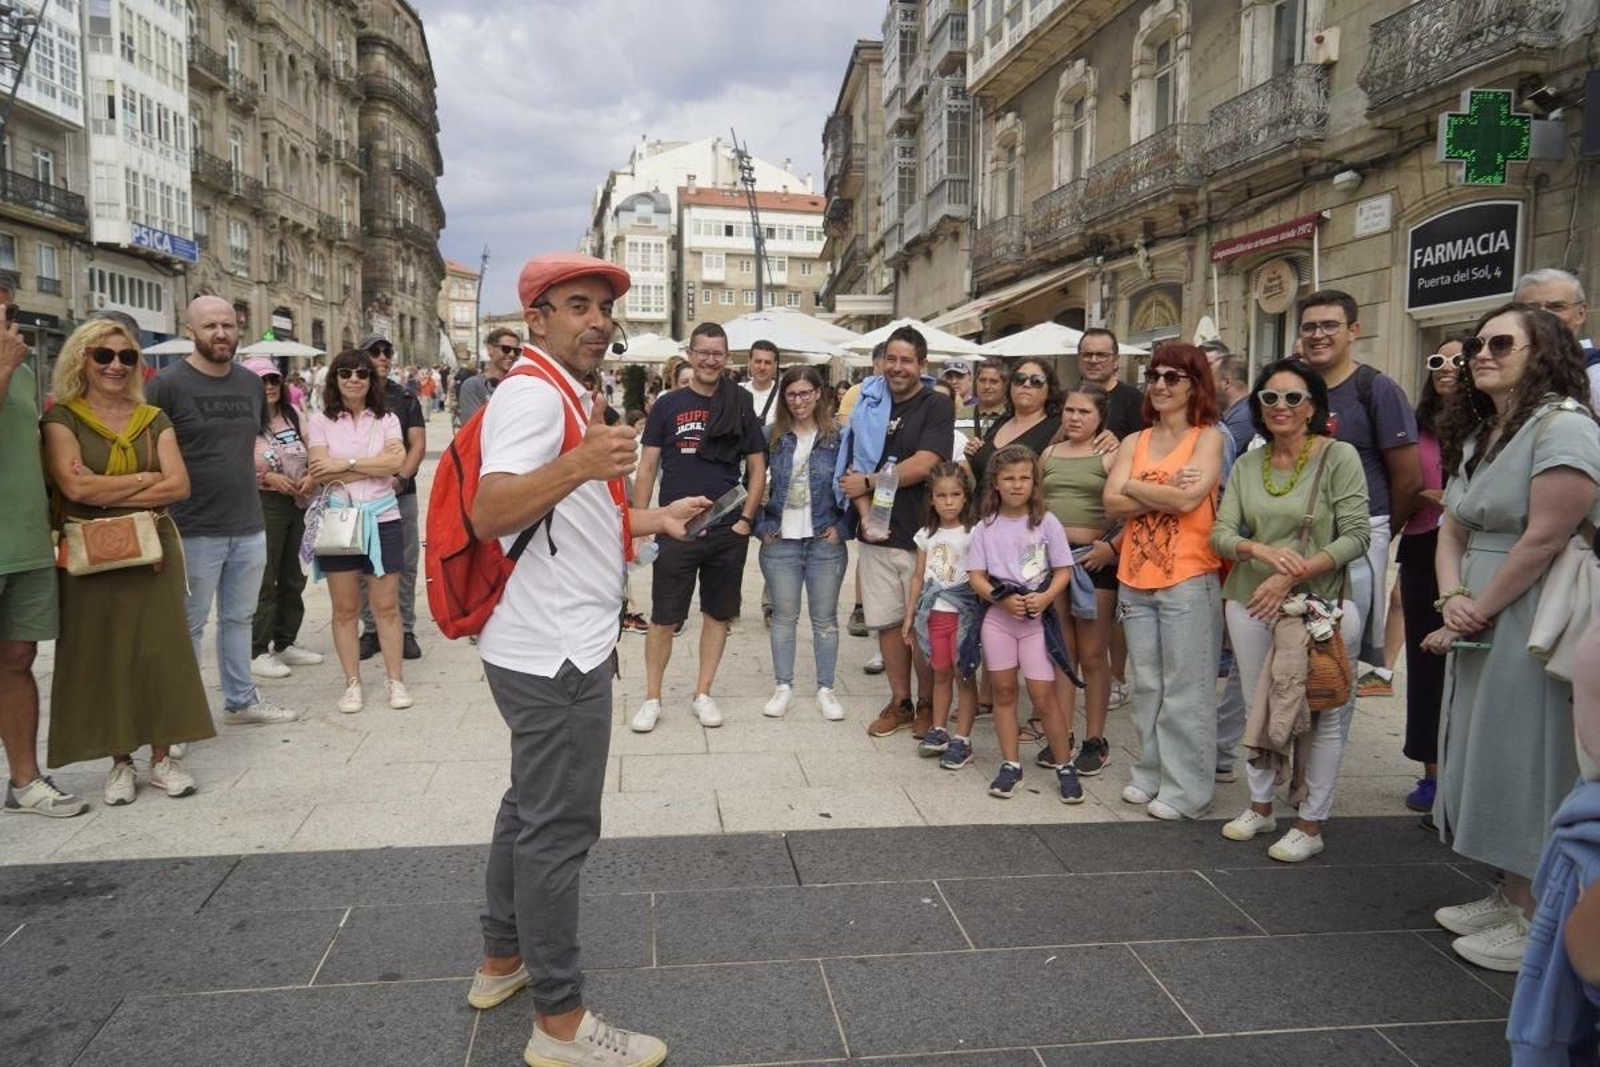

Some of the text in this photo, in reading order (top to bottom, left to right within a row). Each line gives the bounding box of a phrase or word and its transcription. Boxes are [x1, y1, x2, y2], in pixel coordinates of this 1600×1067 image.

[132, 224, 173, 254] PSICA
[1413, 229, 1511, 269] FARMACIA
[1418, 264, 1502, 289] Puerta del Sol, 4
